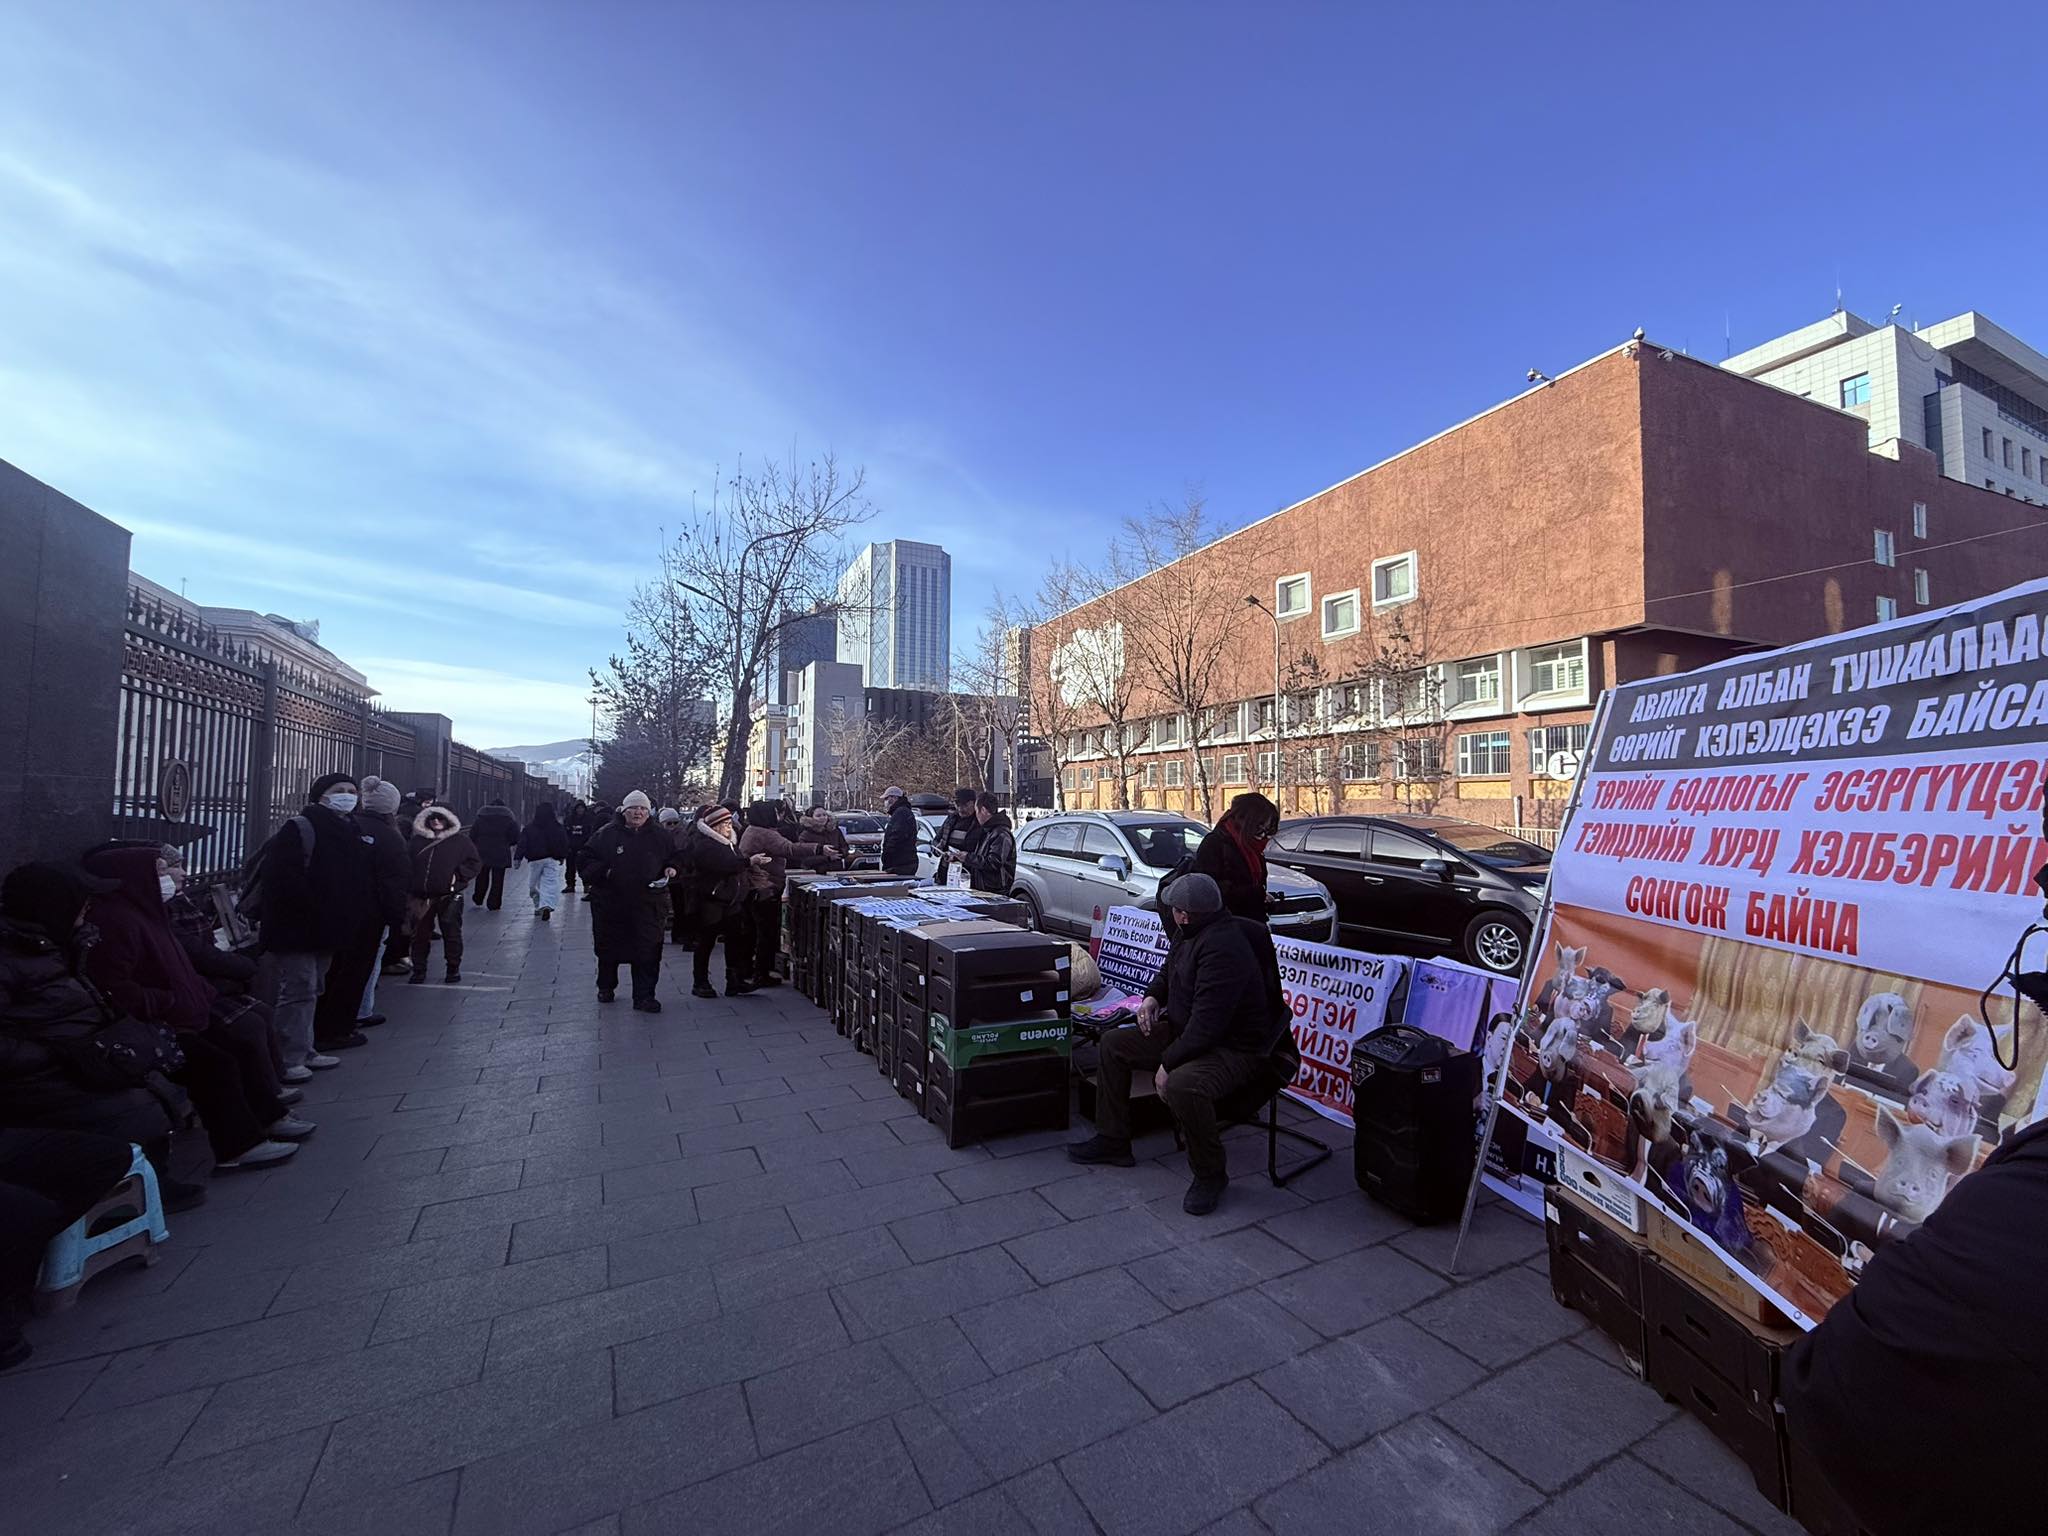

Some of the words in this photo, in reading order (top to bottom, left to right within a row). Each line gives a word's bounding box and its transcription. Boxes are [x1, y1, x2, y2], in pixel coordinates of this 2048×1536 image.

[1629, 683, 1709, 723] АВЛИГА
[1717, 663, 1812, 711] АЛБАН
[1830, 613, 2048, 695] ТУШААЛАА
[1609, 723, 1686, 763] ӨӨРИЙГ
[1694, 704, 1891, 758] ХЭЛЭЛЦЭХЭЭ
[1592, 773, 1665, 811] ТӨРИЙН
[1666, 772, 1810, 816] БОДЛОГЫГ
[1574, 818, 1696, 863] ТЭМЦЛИЙН
[1699, 827, 1781, 878] ХУРЦ
[1107, 926, 1129, 940] ХУУЛЬ
[1130, 930, 1154, 945] ЁСООР
[1625, 875, 1730, 931] СОНГОЖ
[1745, 887, 1859, 957] БАЙНА
[1102, 941, 1147, 963] ХАМГААЛБАЛ
[1311, 973, 1375, 1003] БОДЛОО
[1020, 1026, 1068, 1041] movena
[1291, 1061, 1355, 1108] РХТЭЙ
